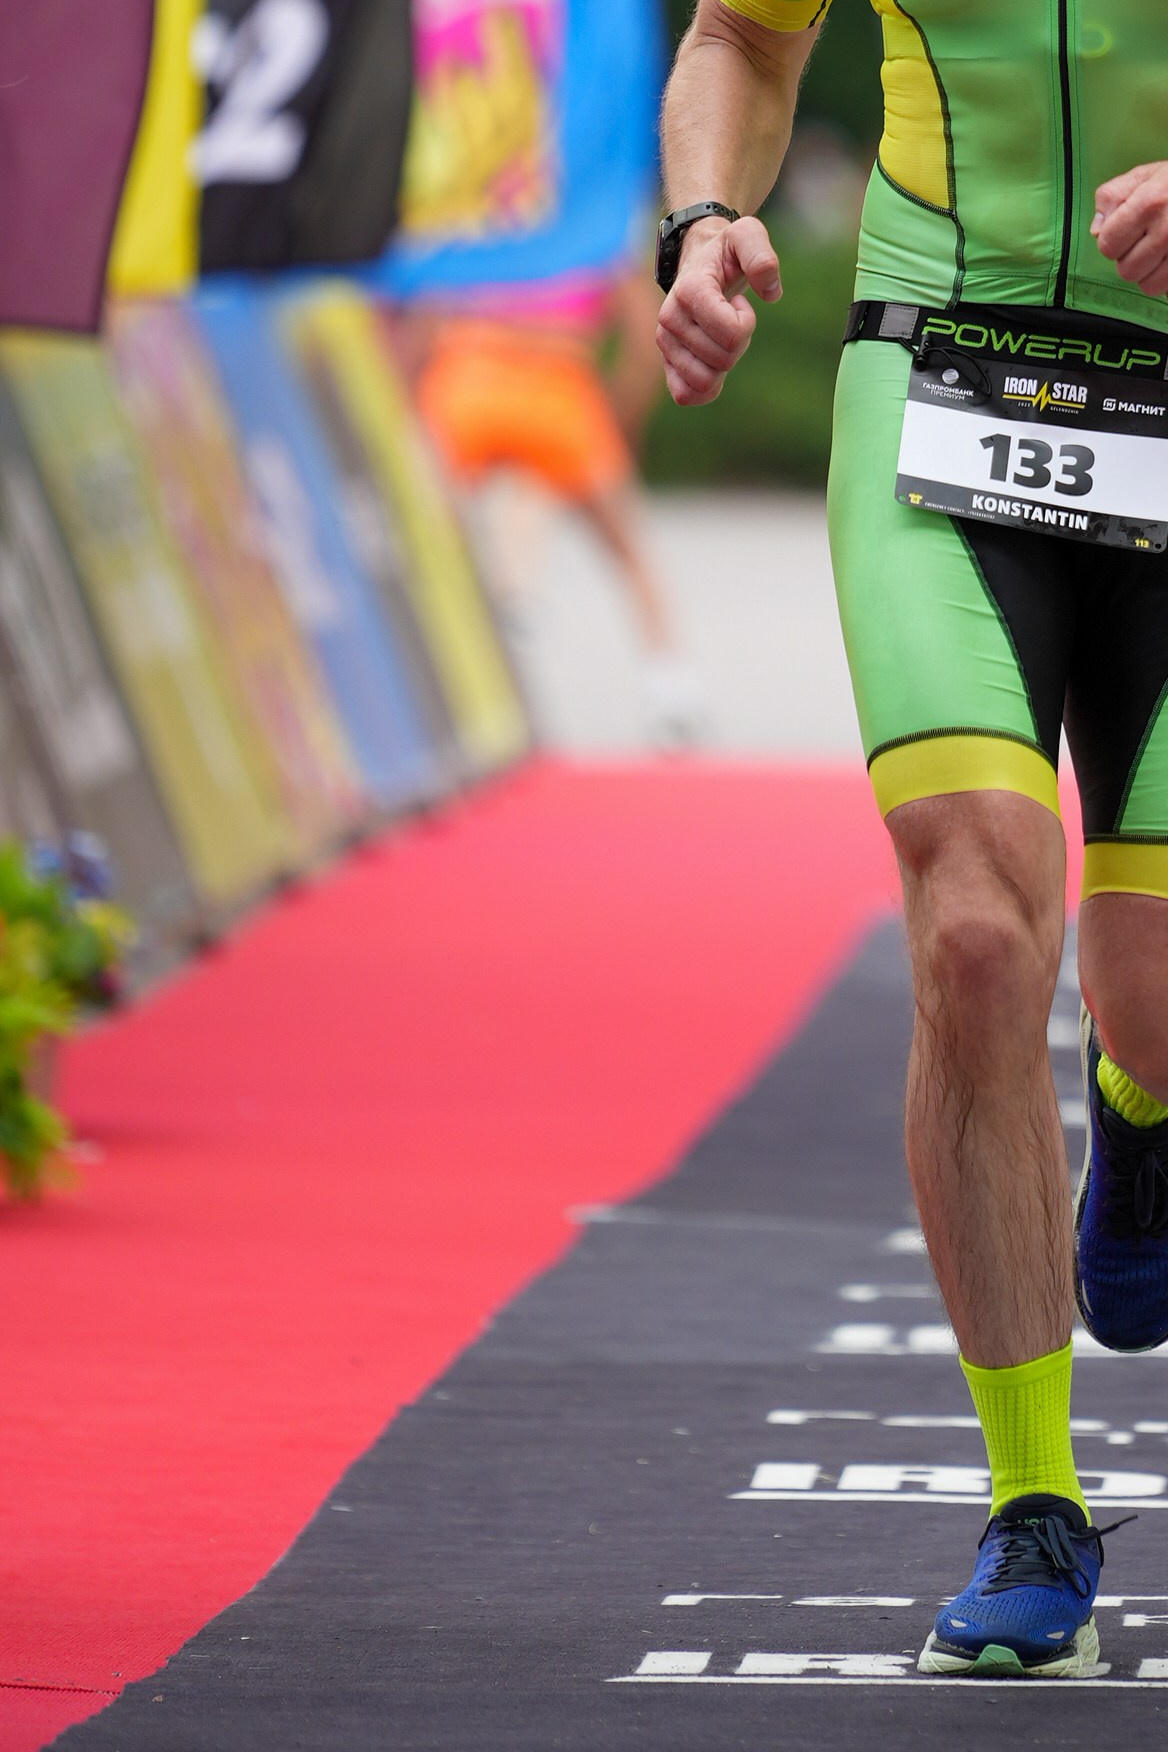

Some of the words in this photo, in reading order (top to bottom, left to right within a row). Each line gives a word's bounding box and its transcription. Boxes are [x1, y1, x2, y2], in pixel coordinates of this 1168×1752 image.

[922, 317, 1161, 371] POWERUP
[922, 382, 974, 398] ГАЗПРОМБАНК
[930, 389, 965, 401] ПРЕМИУМ
[1004, 376, 1038, 396] IRON
[1052, 381, 1088, 404] STAR
[1118, 401, 1166, 417] МАГНИТ
[979, 433, 1096, 496] 133
[971, 494, 1089, 531] KONSTANTIN
